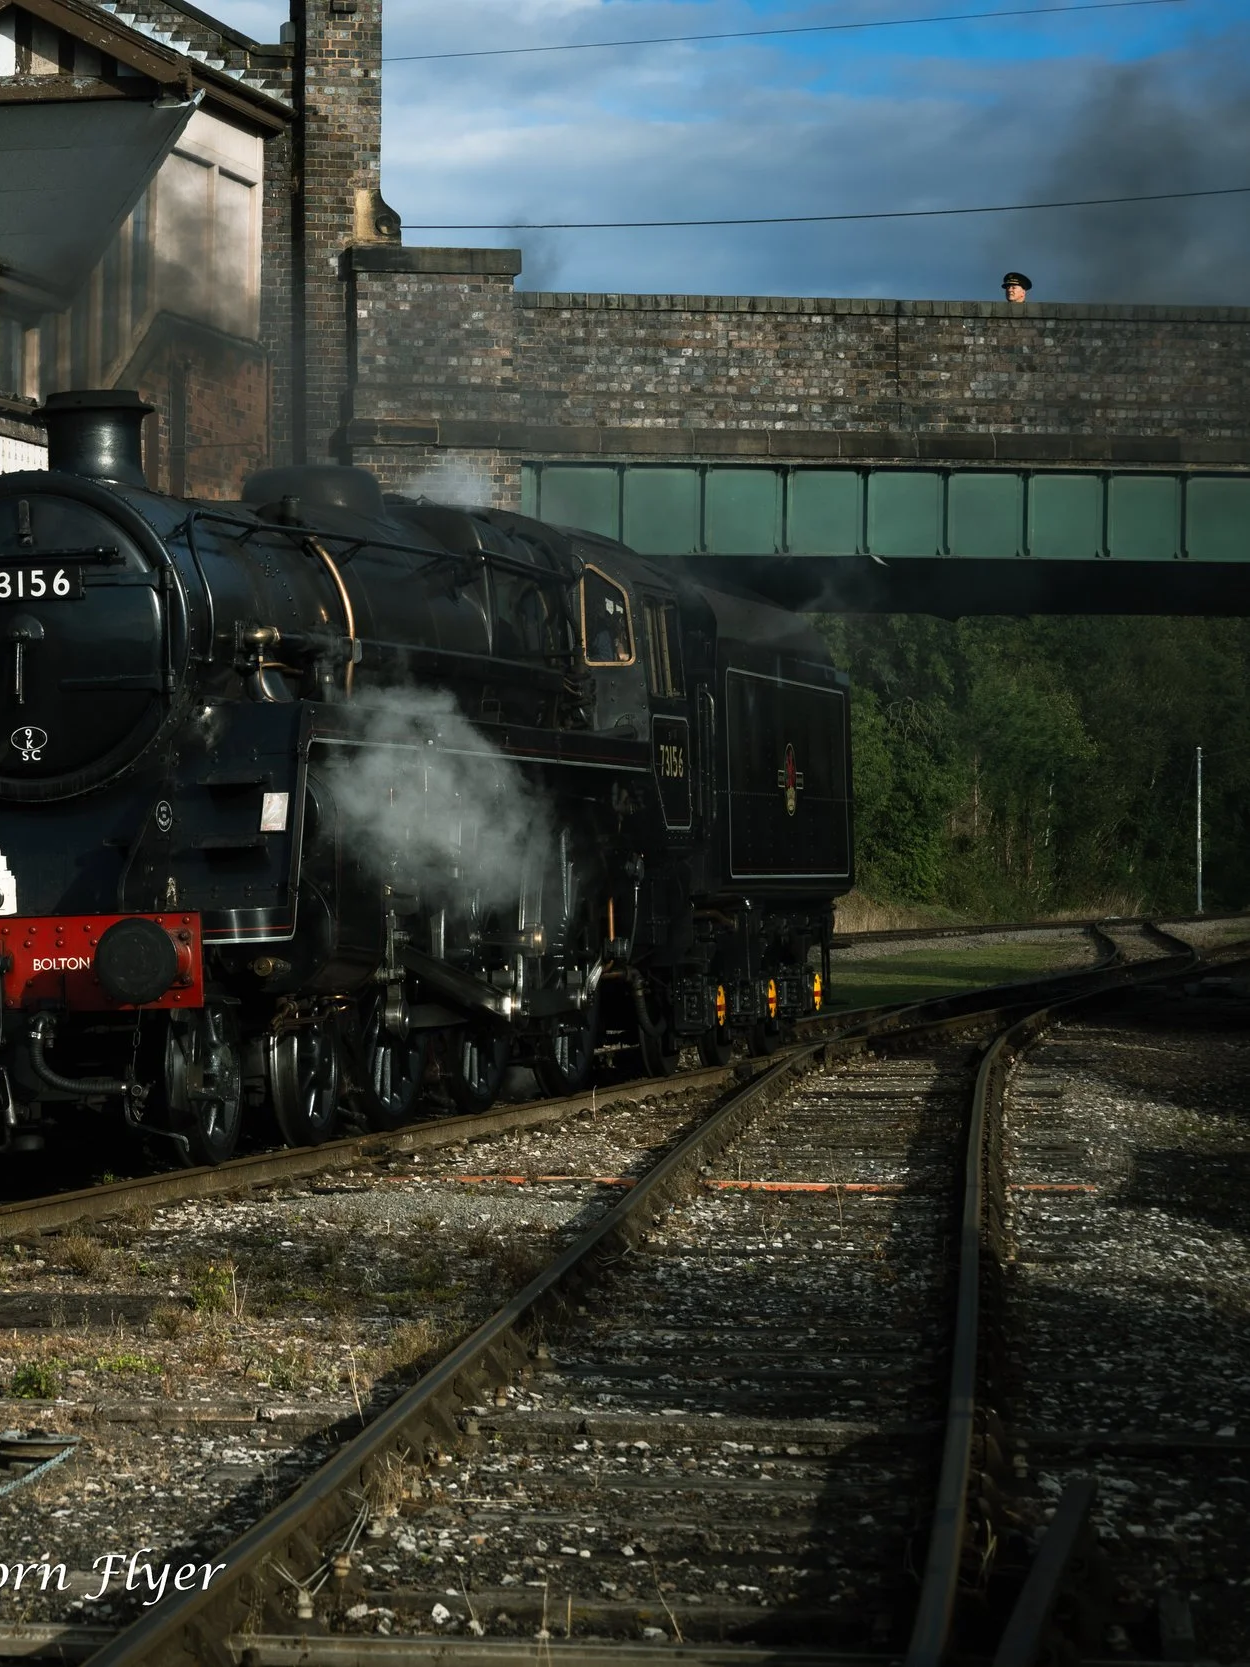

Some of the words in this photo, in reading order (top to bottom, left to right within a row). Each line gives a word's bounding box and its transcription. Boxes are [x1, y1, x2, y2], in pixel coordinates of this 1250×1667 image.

[24, 728, 33, 740] 9
[25, 739, 34, 749] K
[21, 749, 42, 761] SC
[659, 744, 684, 778] 73156
[33, 956, 90, 972] BOLTON
